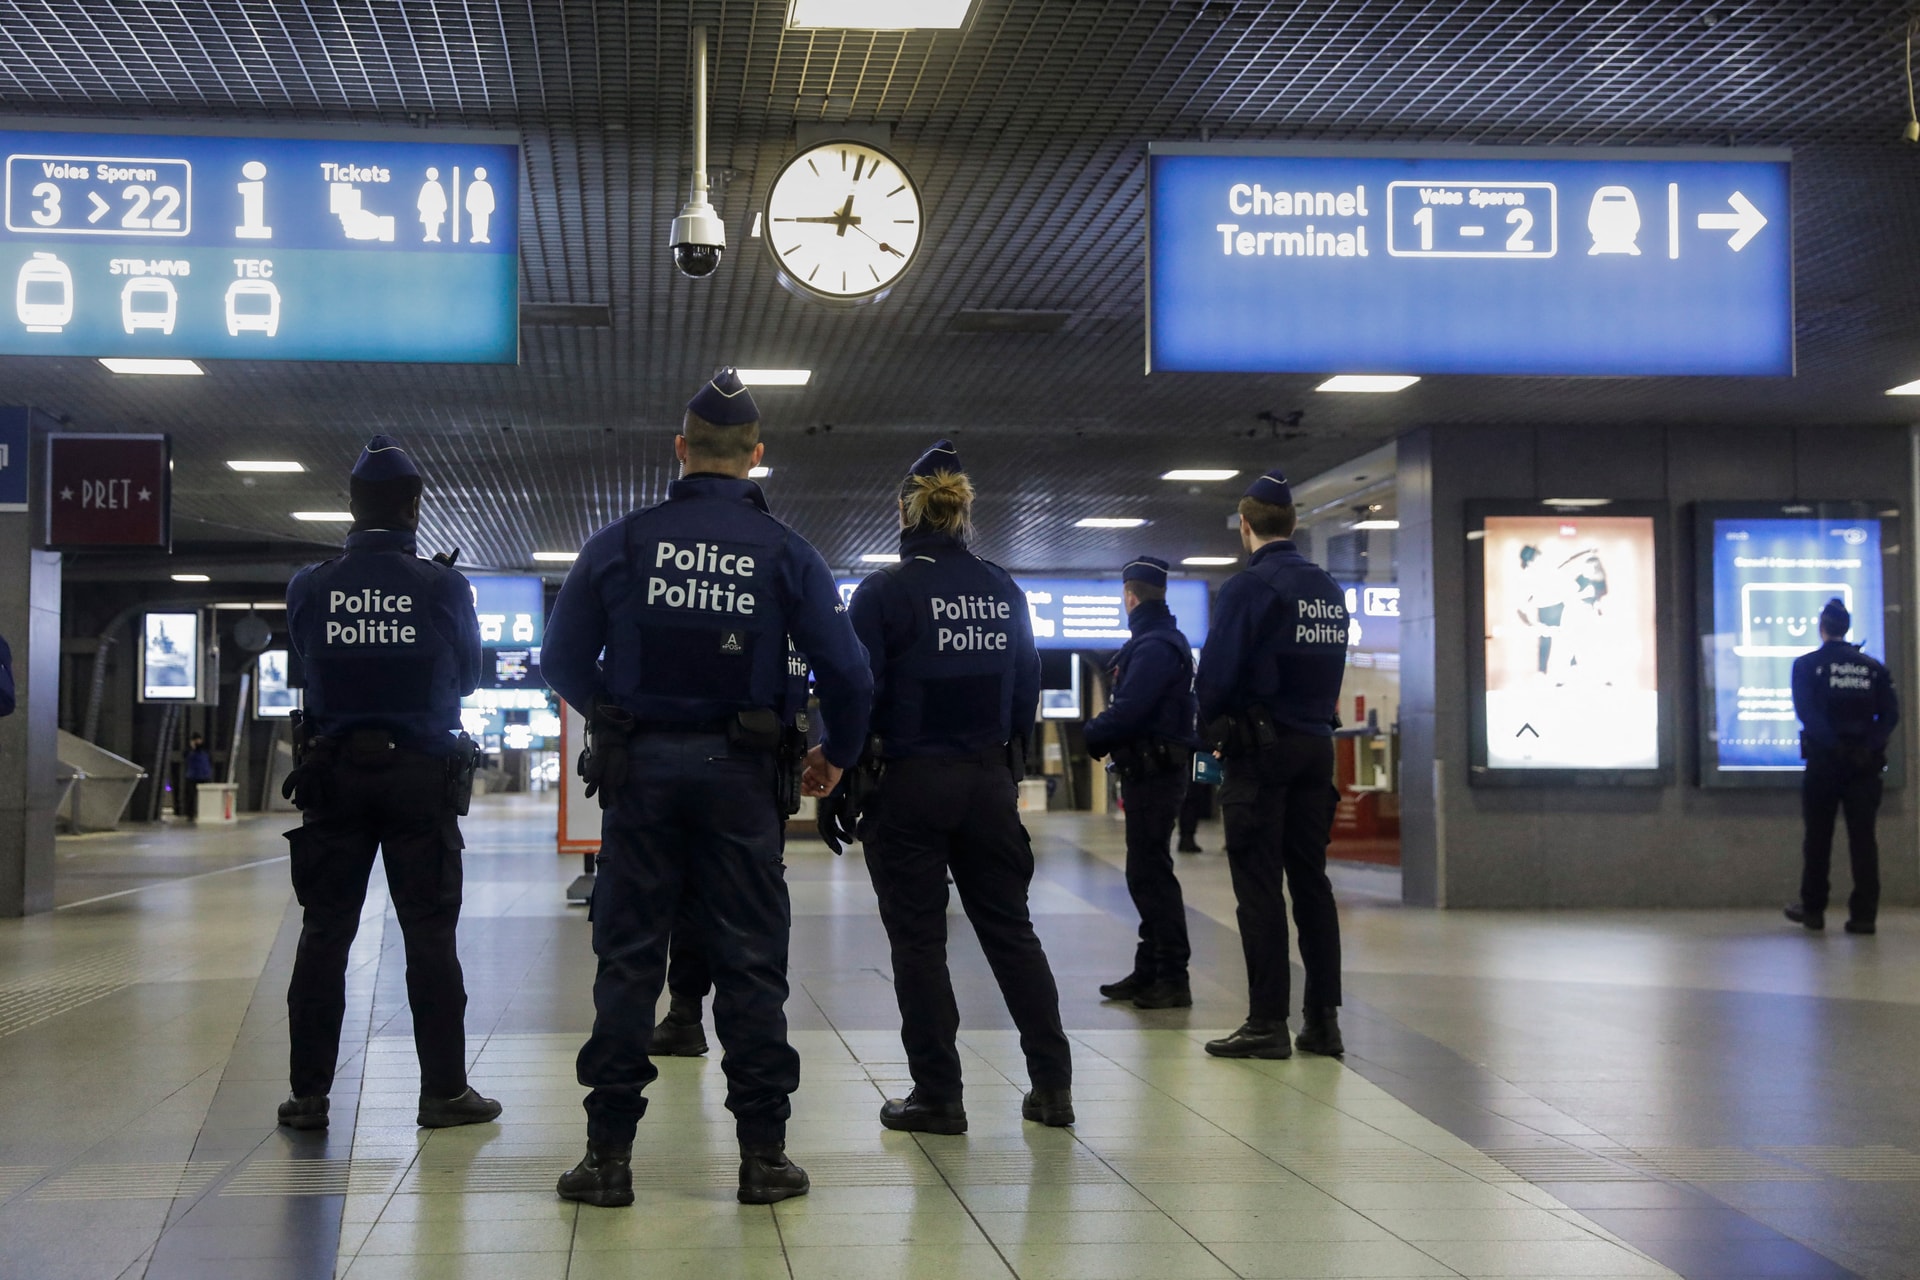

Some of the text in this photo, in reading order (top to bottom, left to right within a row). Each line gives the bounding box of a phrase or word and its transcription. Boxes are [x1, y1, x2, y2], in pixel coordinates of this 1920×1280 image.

[42, 162, 157, 184] Voies Sporen
[320, 163, 391, 183] Tickets
[31, 182, 61, 226] 3
[121, 185, 181, 229] 22
[1229, 183, 1369, 217] Channel
[1216, 223, 1369, 257] Terminal
[1413, 207, 1433, 250] 1
[1505, 207, 1534, 252] 2
[233, 258, 274, 278] TEC
[82, 479, 131, 509] PRET
[656, 541, 755, 577] Police
[330, 588, 413, 614] Police
[647, 577, 755, 614] Politie
[930, 595, 1011, 621] Politie
[1297, 598, 1344, 620] Police
[326, 619, 417, 645] Politie
[727, 633, 737, 645] A
[938, 625, 1008, 652] Police
[1295, 623, 1346, 644] Politie
[787, 655, 807, 677] itie
